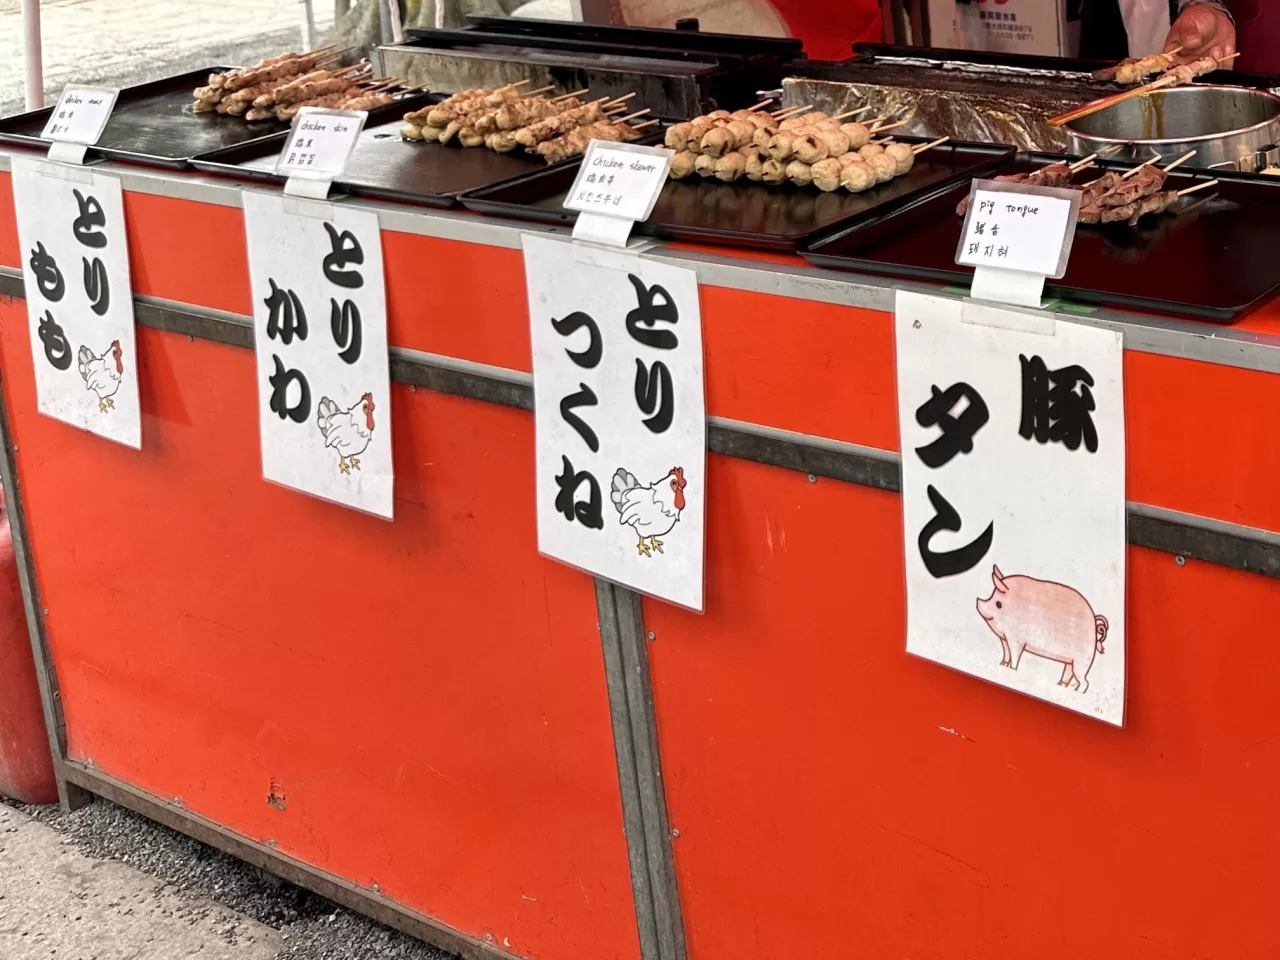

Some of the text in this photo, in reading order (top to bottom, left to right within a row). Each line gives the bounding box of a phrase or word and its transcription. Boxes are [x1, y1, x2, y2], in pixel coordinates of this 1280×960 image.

[73, 187, 109, 316] とり
[1006, 203, 1039, 218] tongue
[30, 240, 73, 372] もも
[263, 277, 312, 424] かわ
[322, 221, 367, 365] とり
[625, 272, 681, 435] とり
[551, 310, 606, 532] つくね
[1017, 353, 1100, 453] 豚
[914, 381, 995, 579] タン
